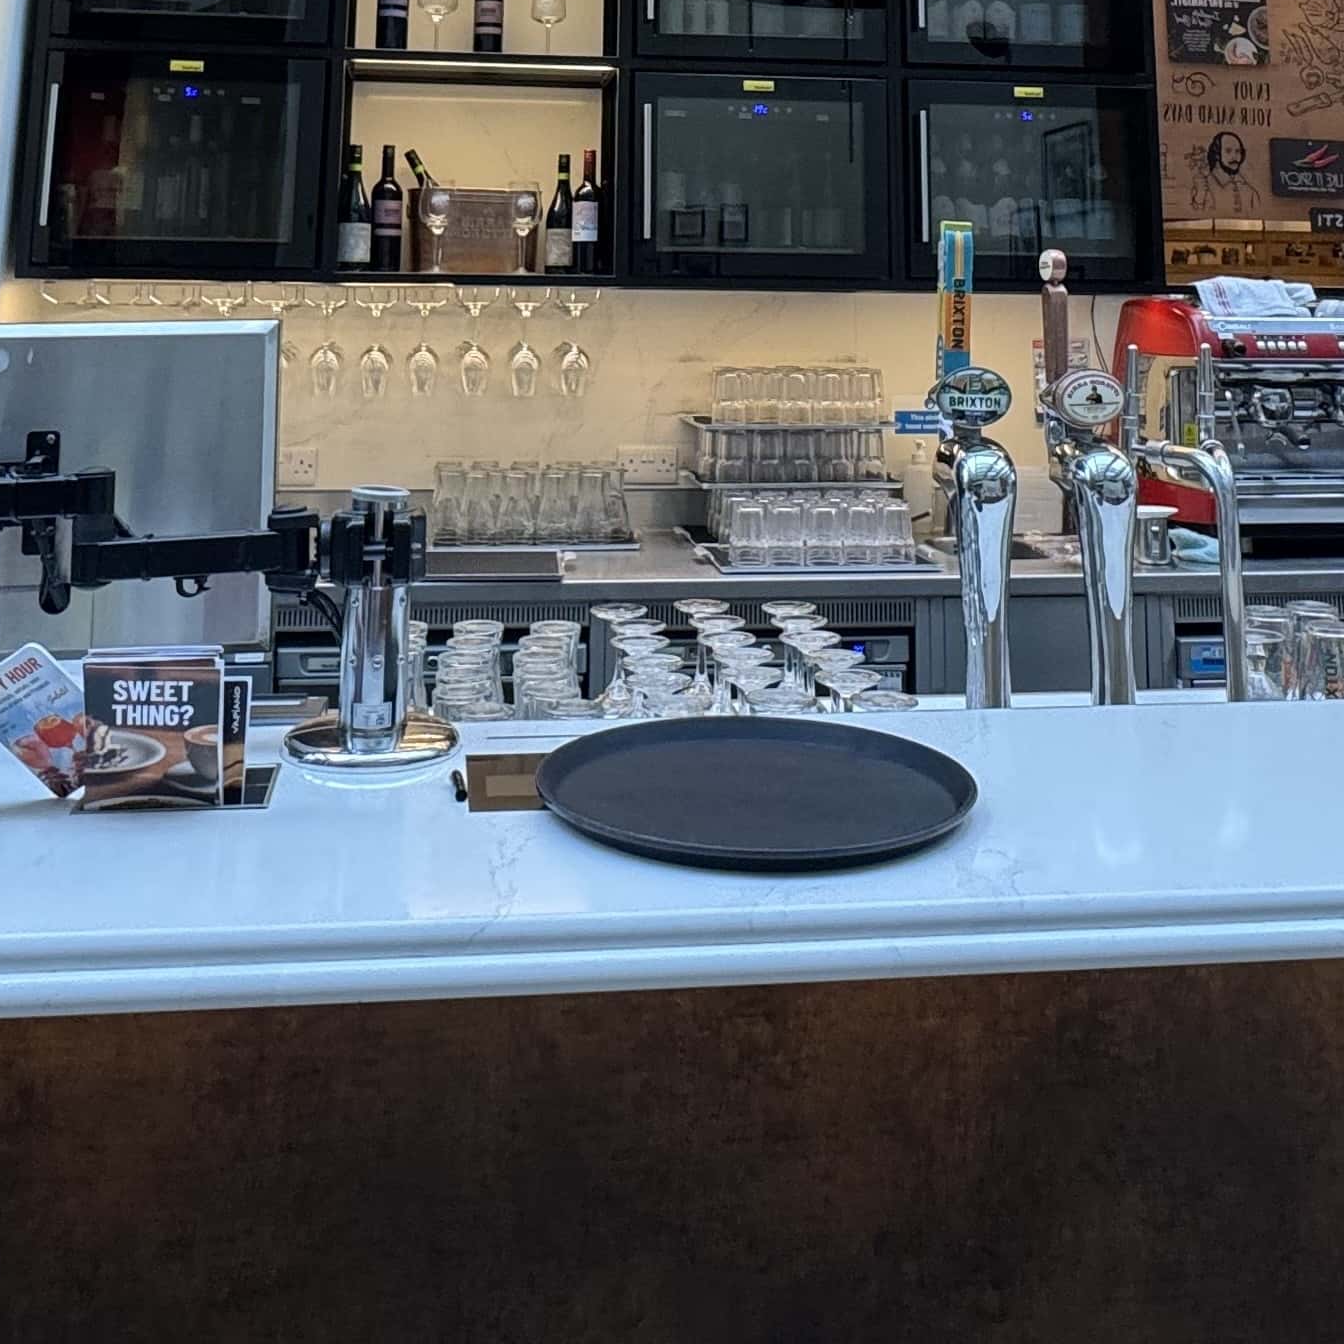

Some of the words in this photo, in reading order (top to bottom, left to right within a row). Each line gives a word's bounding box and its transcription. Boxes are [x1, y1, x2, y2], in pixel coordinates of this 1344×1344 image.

[951, 277, 966, 350] BRIXTON
[948, 395, 1001, 408] BRIXTON
[4, 657, 43, 685] HOUR
[112, 680, 194, 704] SWEET
[112, 703, 194, 727] THING?
